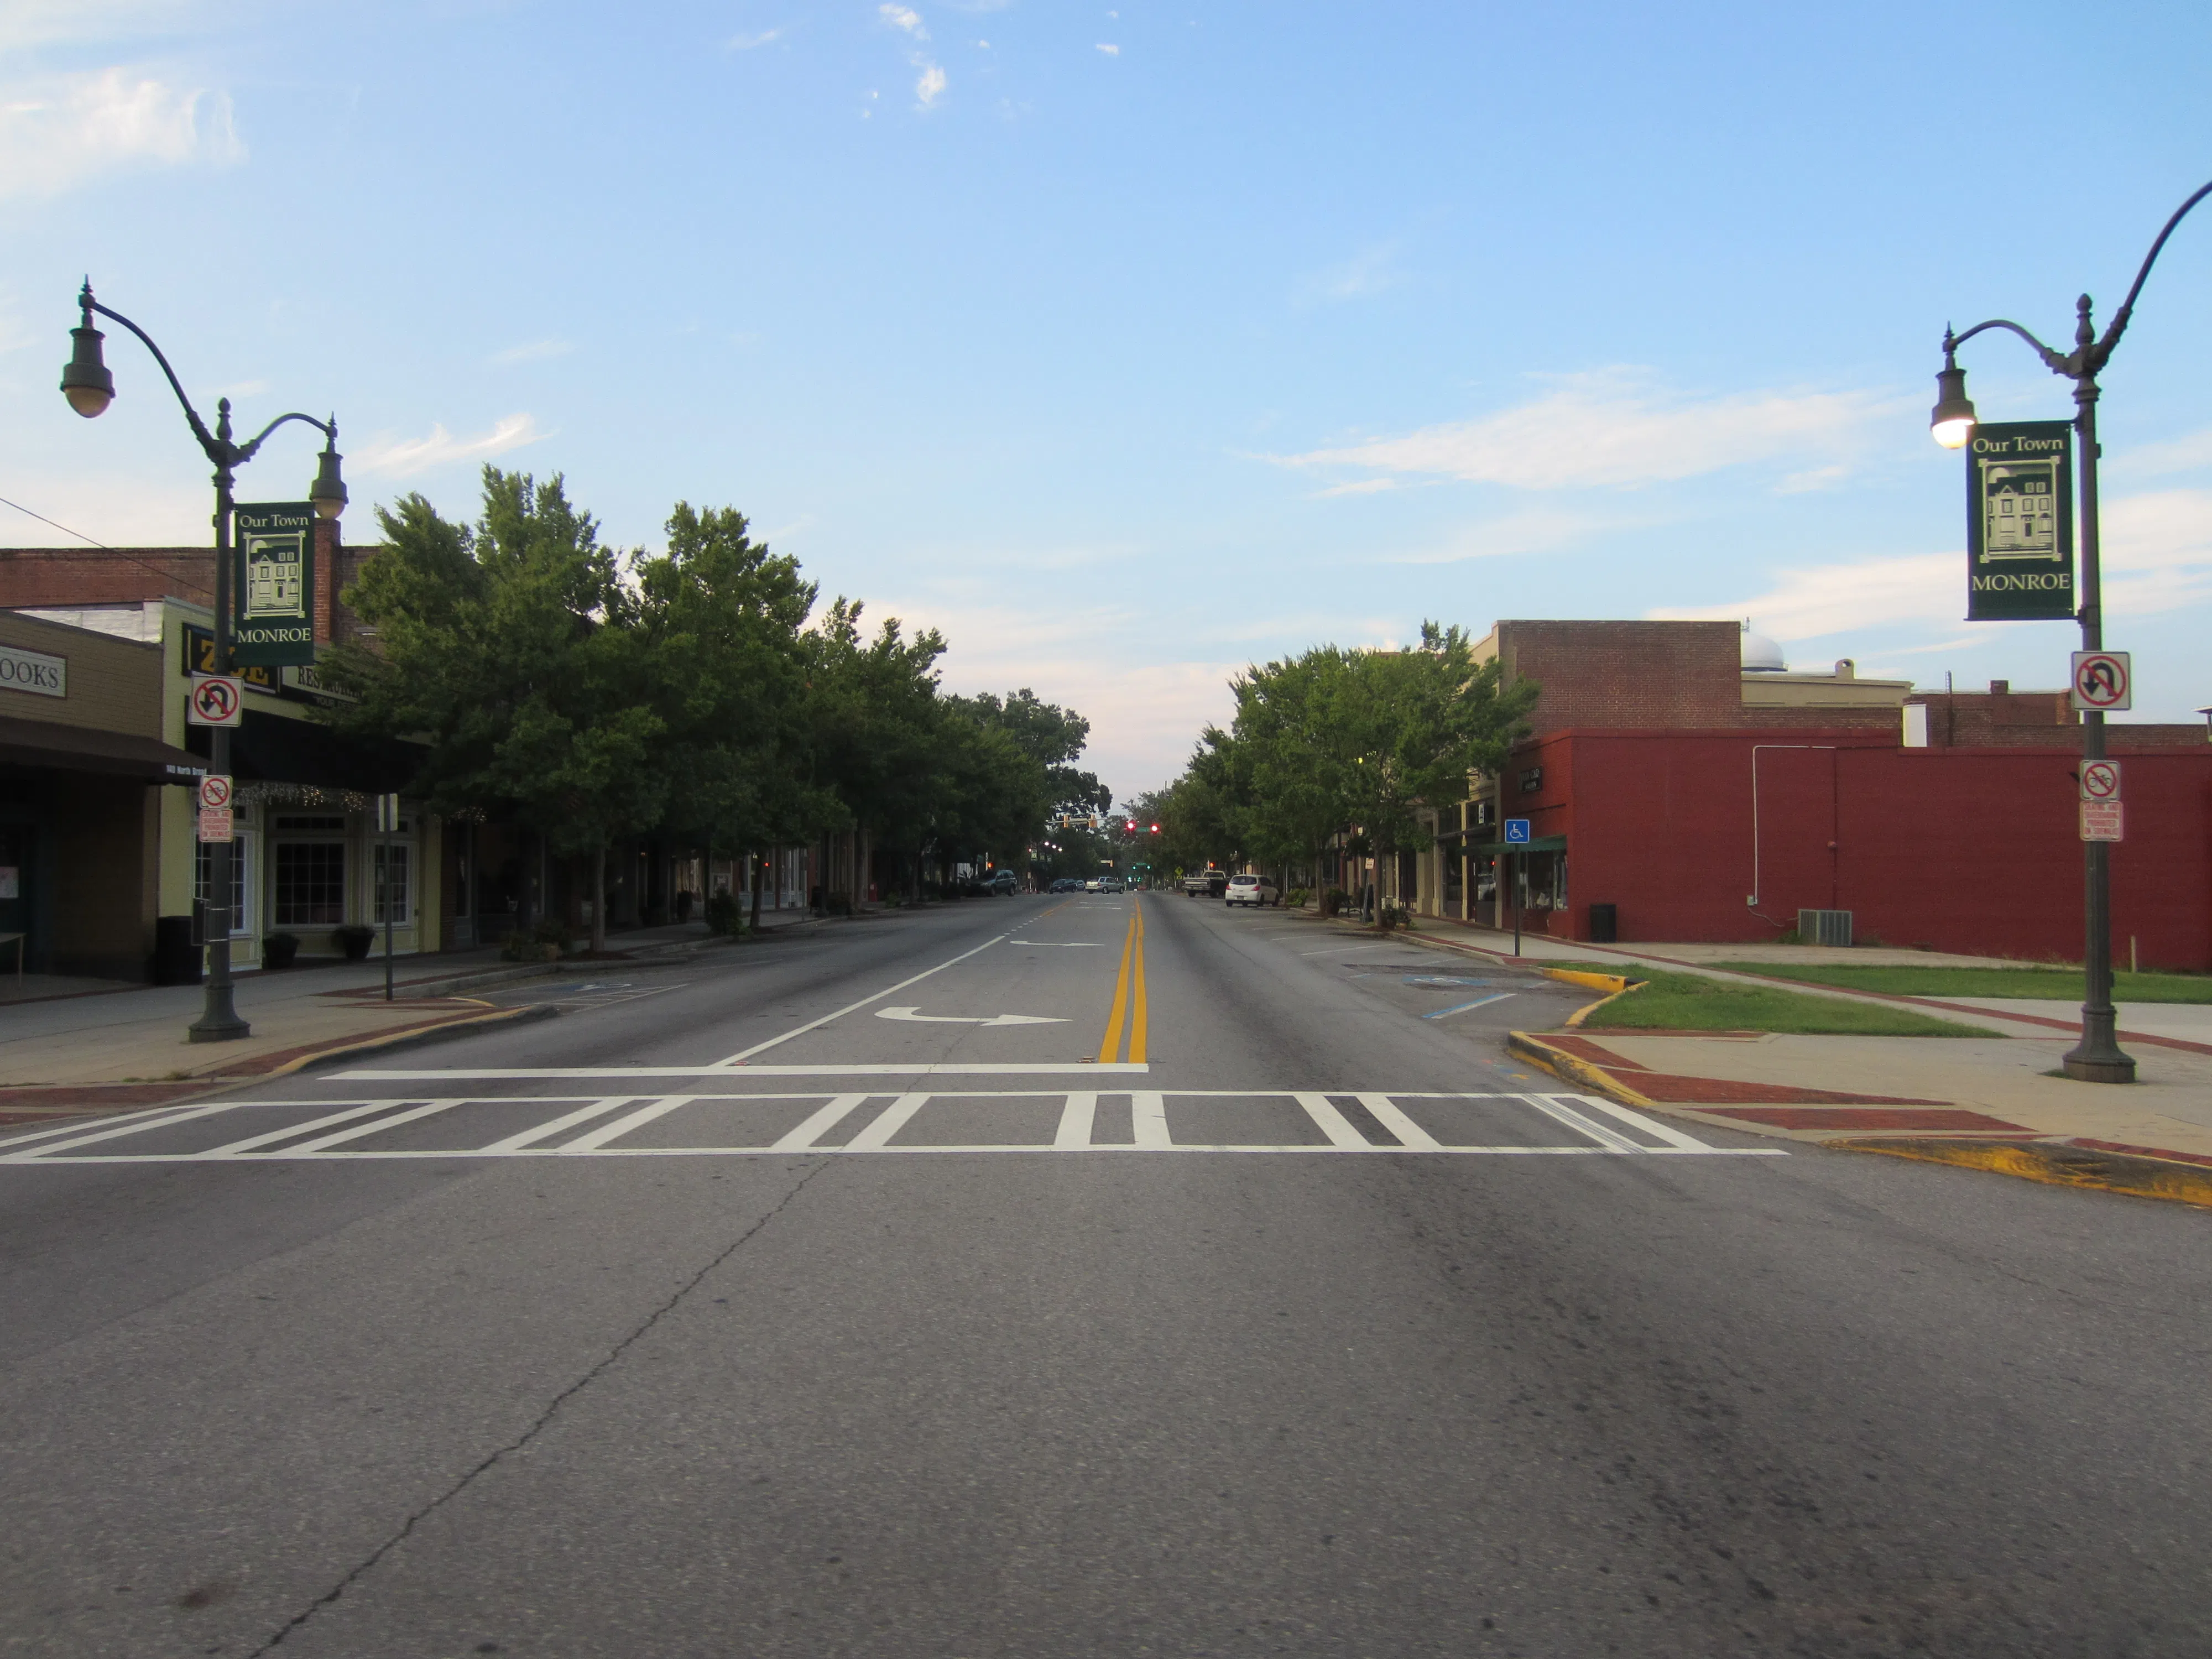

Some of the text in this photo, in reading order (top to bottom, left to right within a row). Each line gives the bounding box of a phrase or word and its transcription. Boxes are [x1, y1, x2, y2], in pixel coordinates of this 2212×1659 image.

[1973, 436, 2063, 453] Our Town
[239, 514, 309, 528] Our Town
[1972, 573, 2071, 591] MONROE
[237, 628, 311, 643] MONROE
